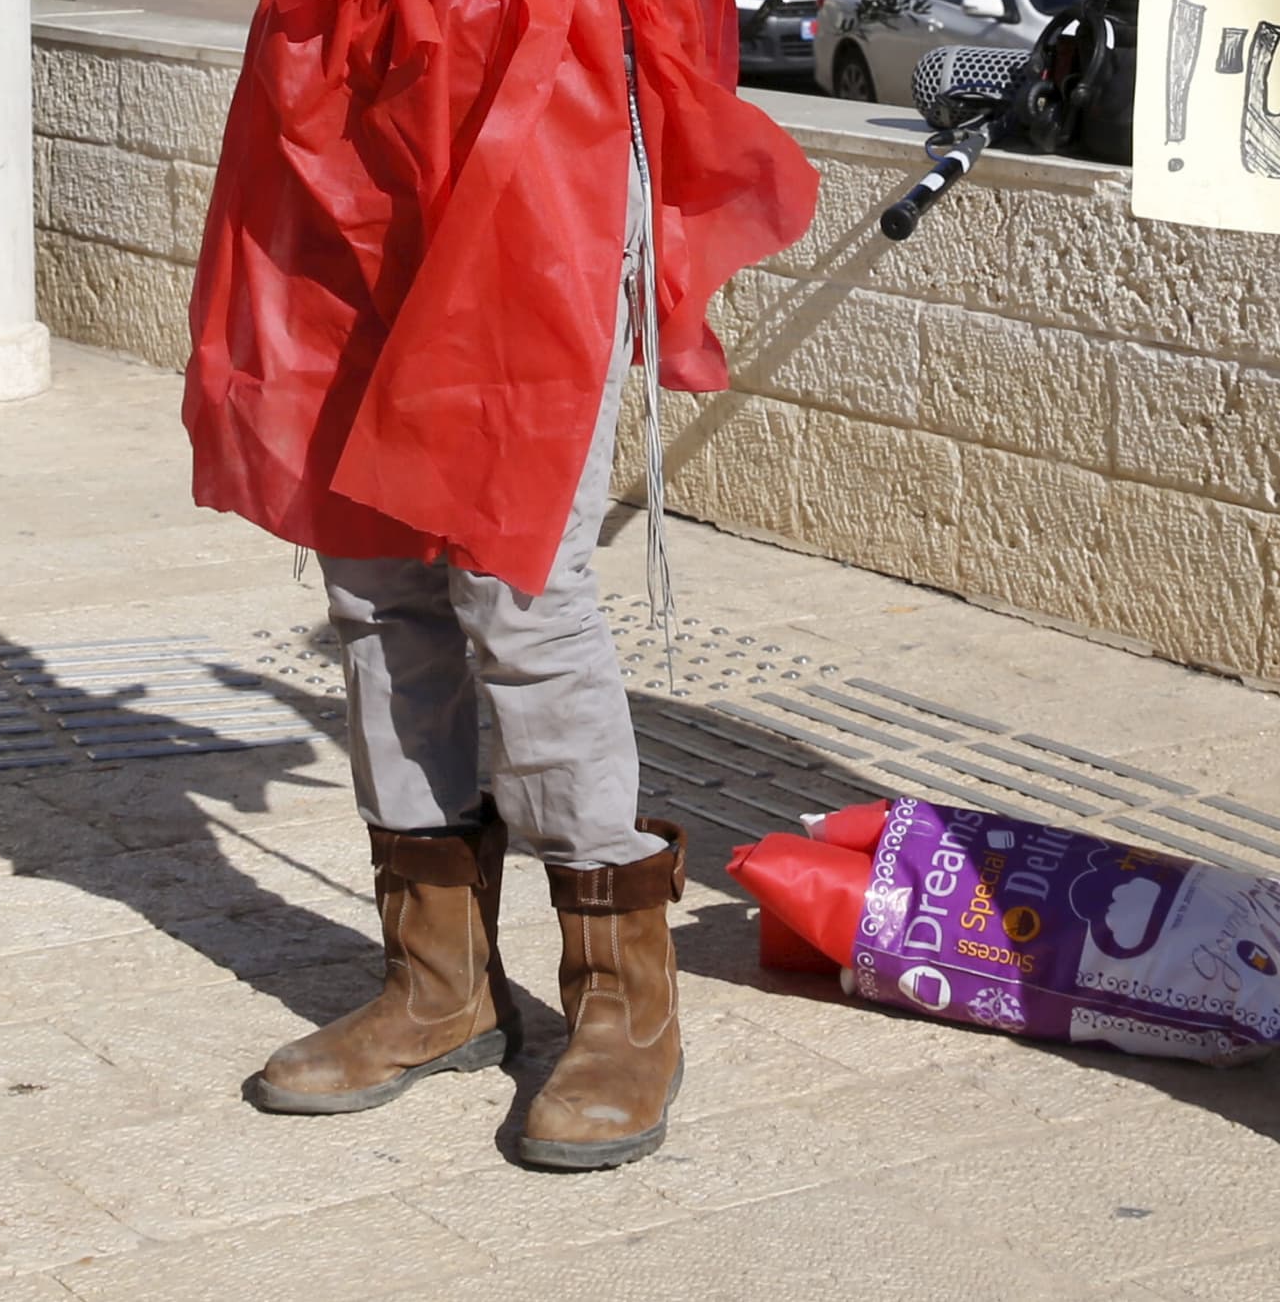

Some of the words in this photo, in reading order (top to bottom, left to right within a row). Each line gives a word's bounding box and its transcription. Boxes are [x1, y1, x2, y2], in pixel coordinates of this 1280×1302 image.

[903, 808, 983, 953] Dreams
[960, 852, 1007, 933] Special
[957, 938, 1035, 973] Success
